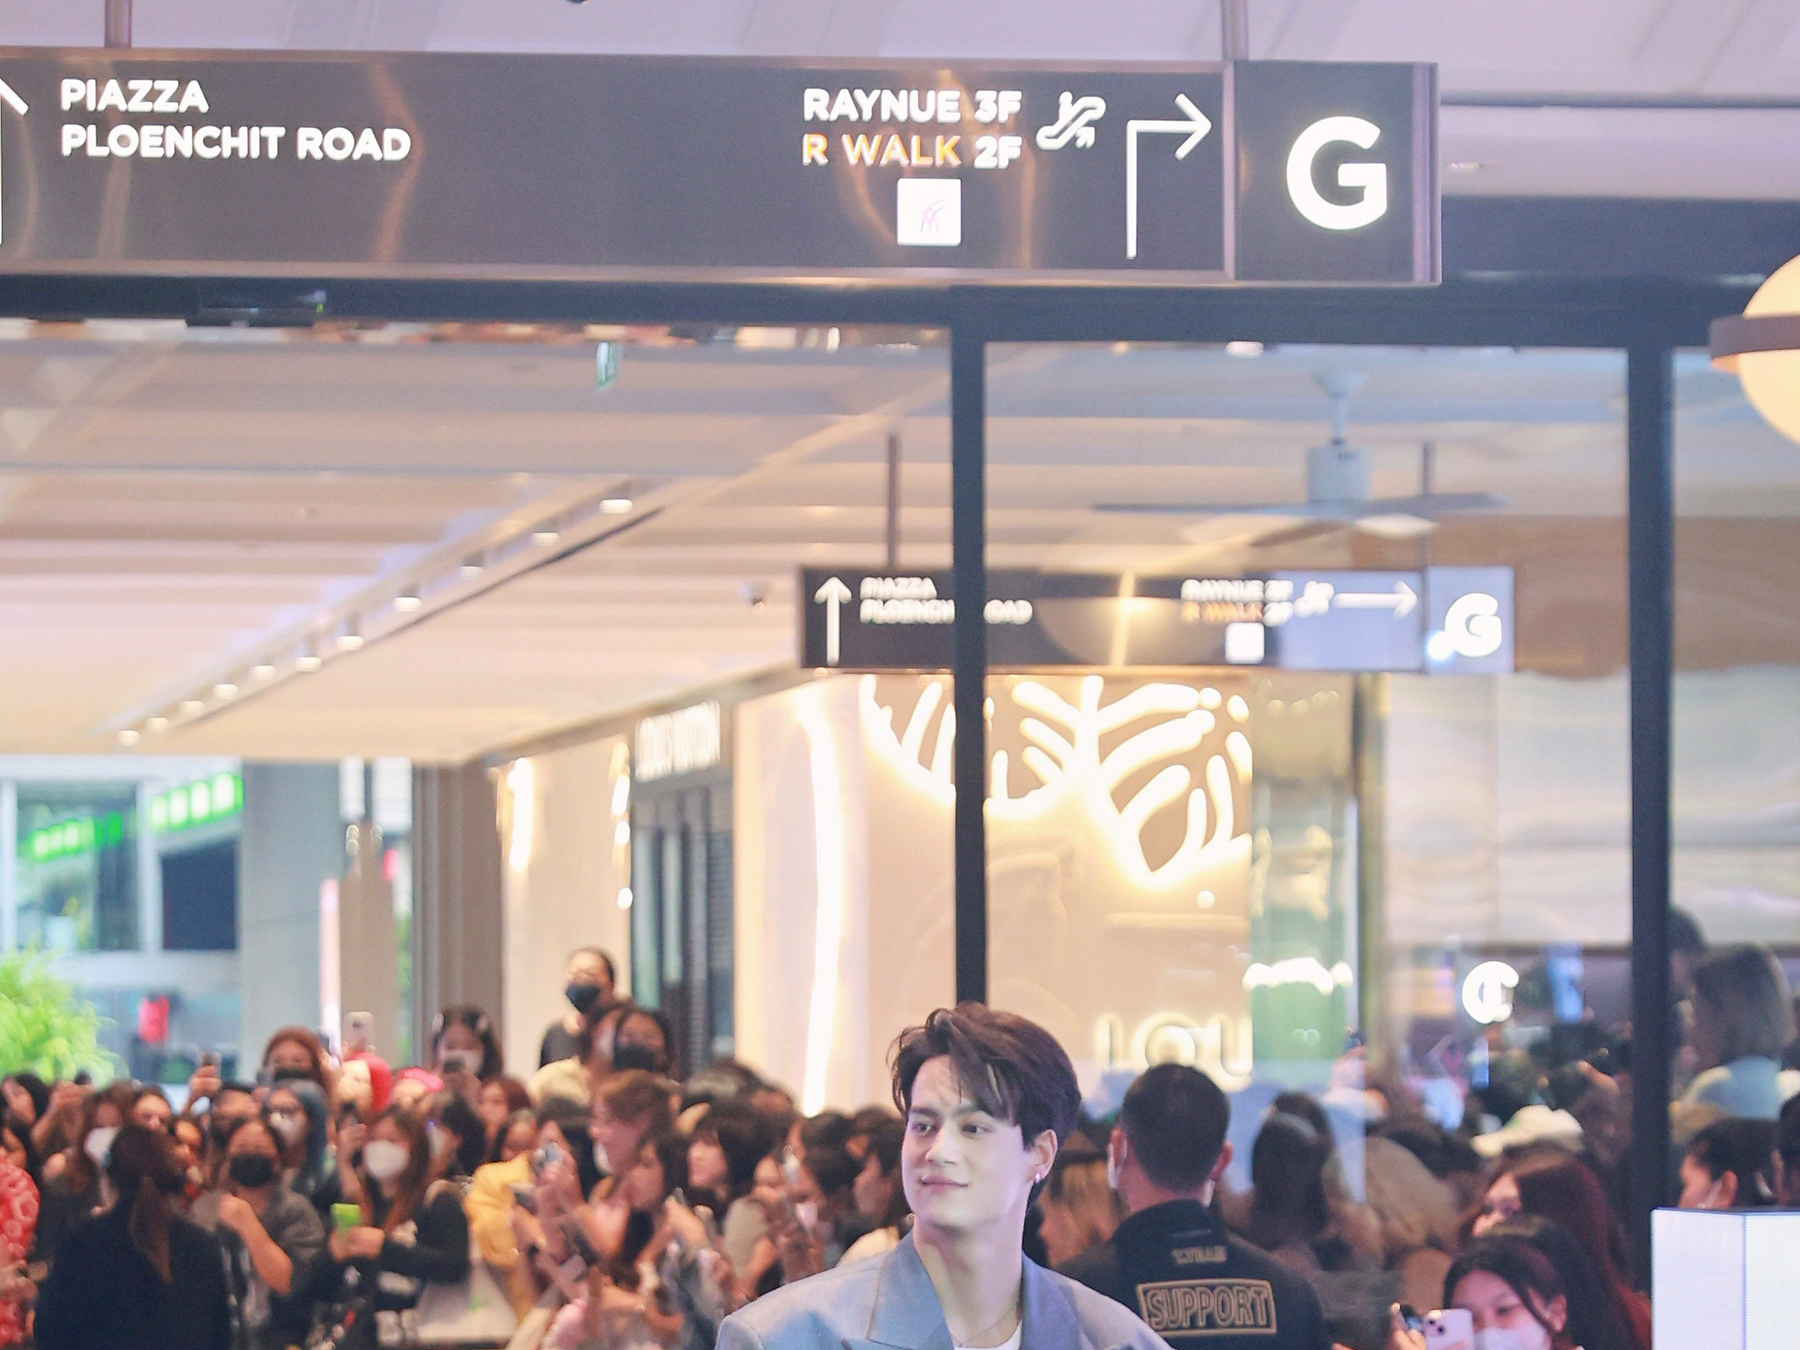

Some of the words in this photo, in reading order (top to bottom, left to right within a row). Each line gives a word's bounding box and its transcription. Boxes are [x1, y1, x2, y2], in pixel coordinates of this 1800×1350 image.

[60, 78, 210, 113] PIAZZA
[802, 88, 961, 122] RAYNUE
[974, 90, 1022, 122] 3F
[61, 124, 286, 159] PLOENCHIT
[297, 127, 412, 161] ROAD
[802, 133, 829, 166] R
[842, 134, 962, 167] WALK
[973, 134, 1022, 169] 2F
[1286, 116, 1388, 231] G
[1146, 1285, 1268, 1331] SUPPORT
